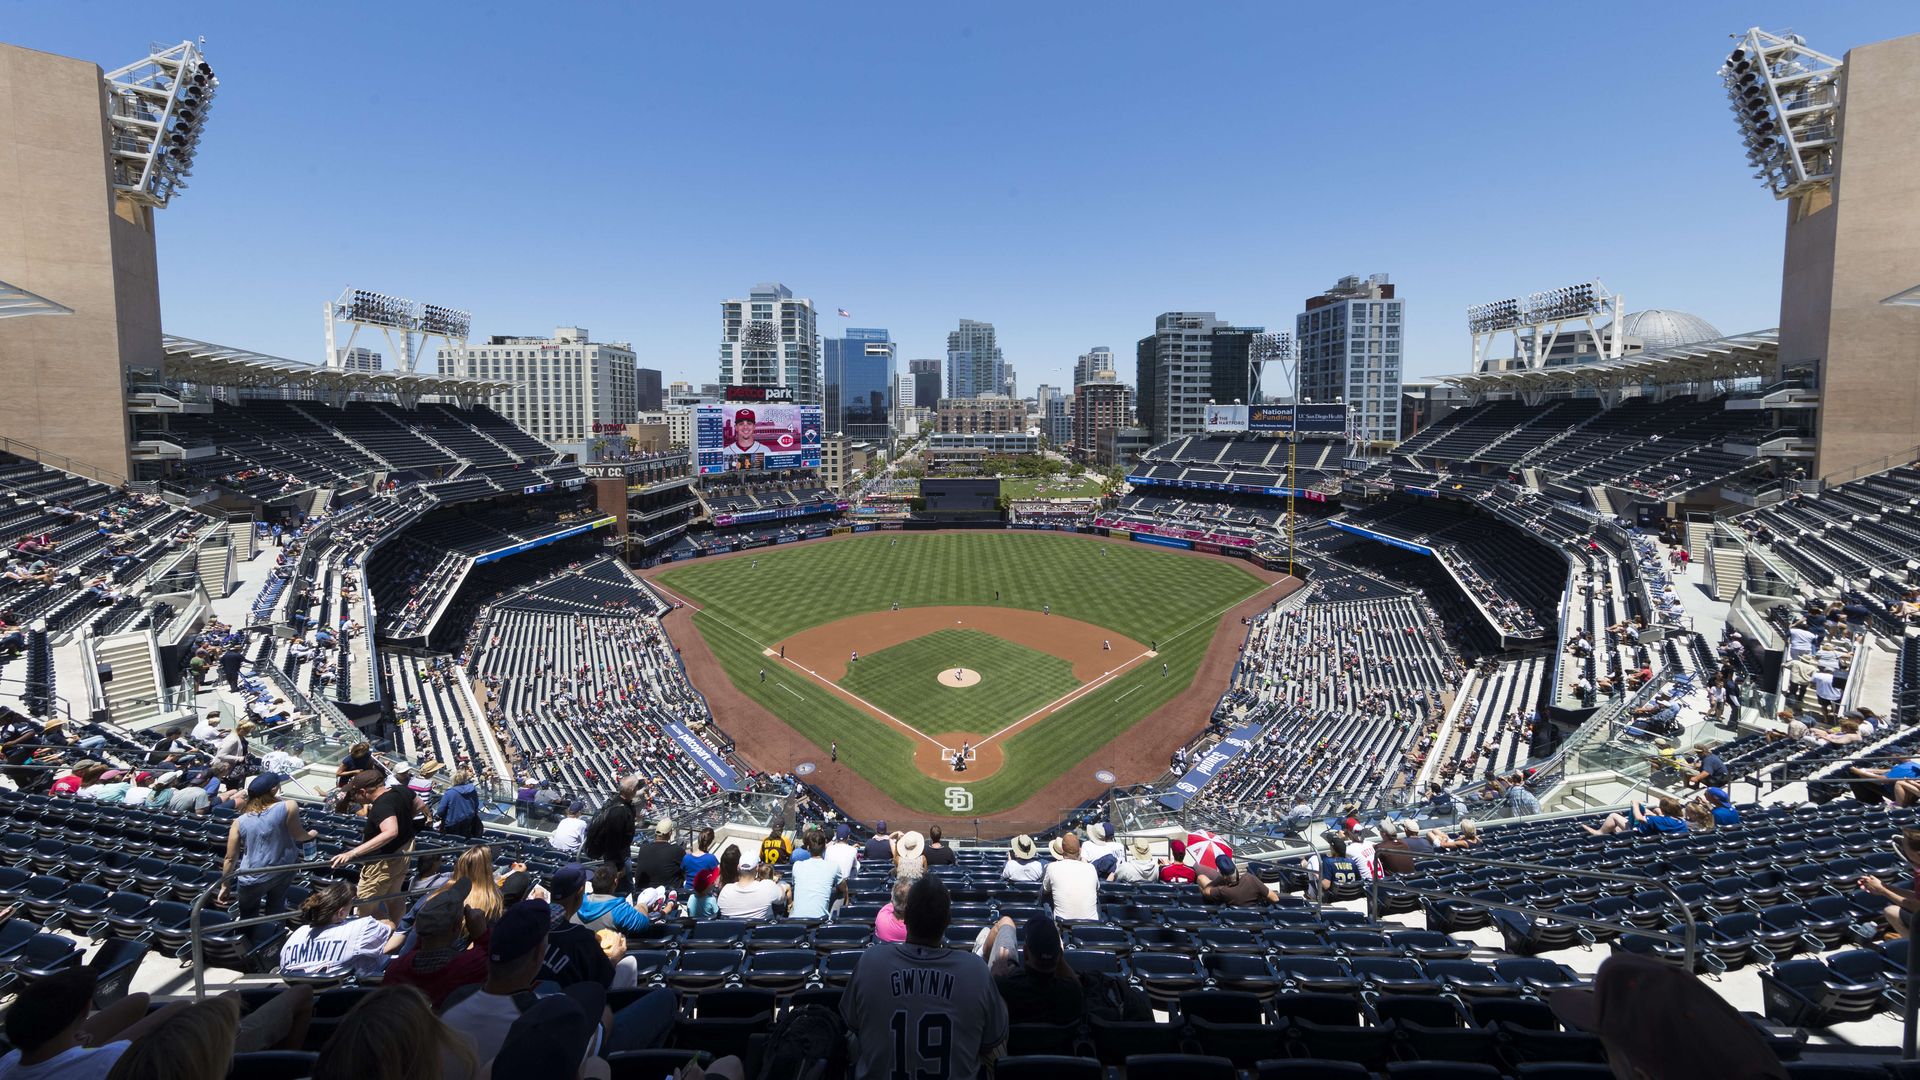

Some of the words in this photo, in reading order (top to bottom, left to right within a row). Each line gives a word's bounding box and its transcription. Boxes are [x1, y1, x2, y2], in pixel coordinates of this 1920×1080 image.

[728, 387, 764, 400] petco
[766, 388, 793, 400] park
[603, 423, 627, 432] TOYOTA
[787, 424, 794, 433] 4
[608, 467, 625, 478] CO.
[626, 463, 649, 474] WESTERN
[650, 461, 664, 470] METAL
[665, 458, 680, 468] SUPPLY
[833, 527, 850, 535] DEWALT
[777, 536, 798, 544] GEICO
[1196, 751, 1230, 776] PADRES
[944, 786, 973, 812] SD
[764, 848, 780, 865] 19
[284, 939, 348, 966] CAMINITI
[890, 967, 955, 1001] GWYNN
[889, 1009, 953, 1080] 19
